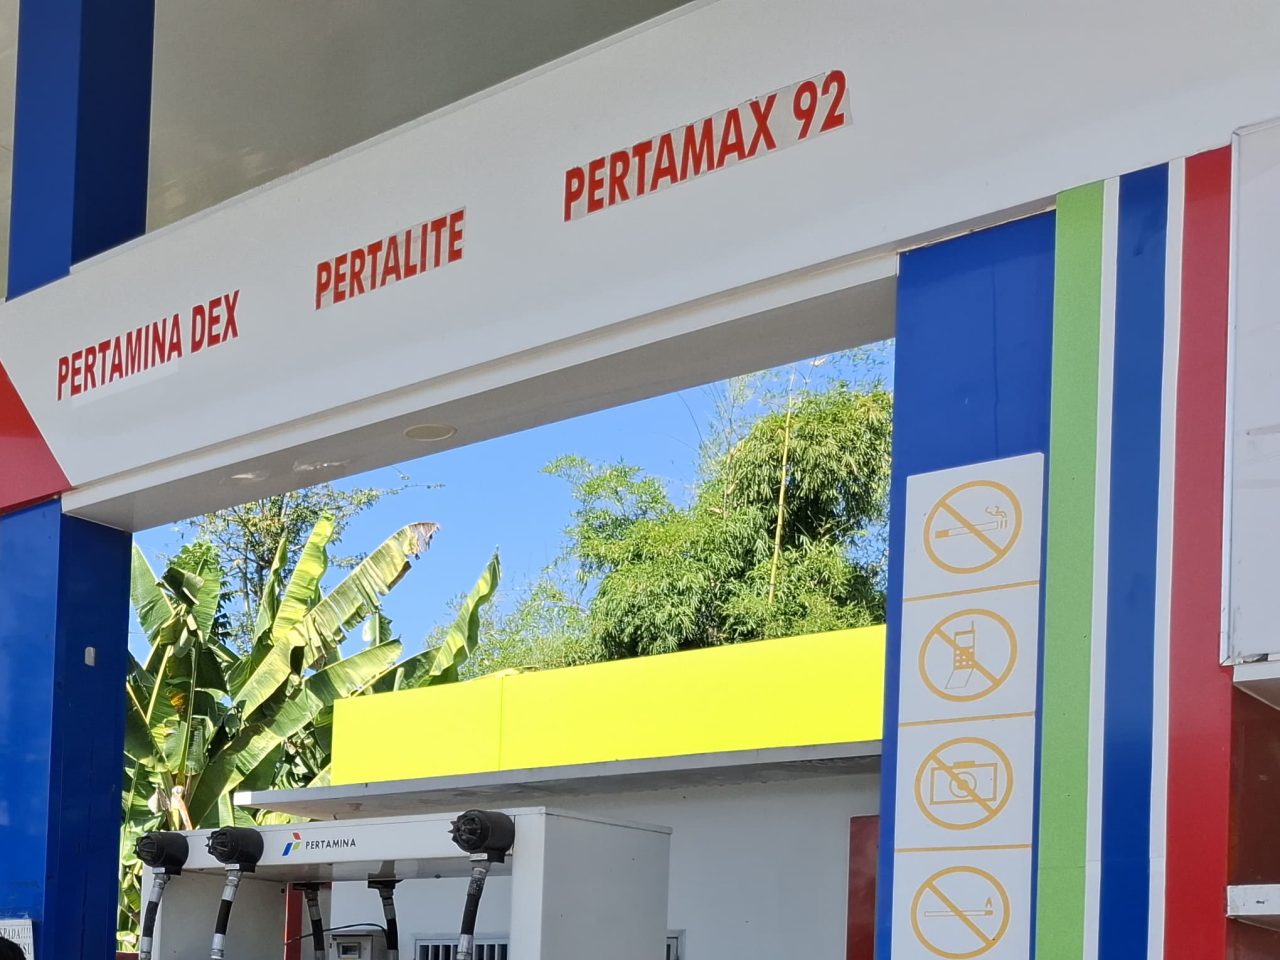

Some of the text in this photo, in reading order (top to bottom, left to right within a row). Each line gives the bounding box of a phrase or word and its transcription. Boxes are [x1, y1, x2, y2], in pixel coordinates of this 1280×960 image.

[564, 70, 847, 222] PERTAMAX 92
[315, 210, 465, 311] PERTALITE
[57, 289, 240, 401] PERTAMINA DEX
[305, 839, 356, 850] PERTAMINA
